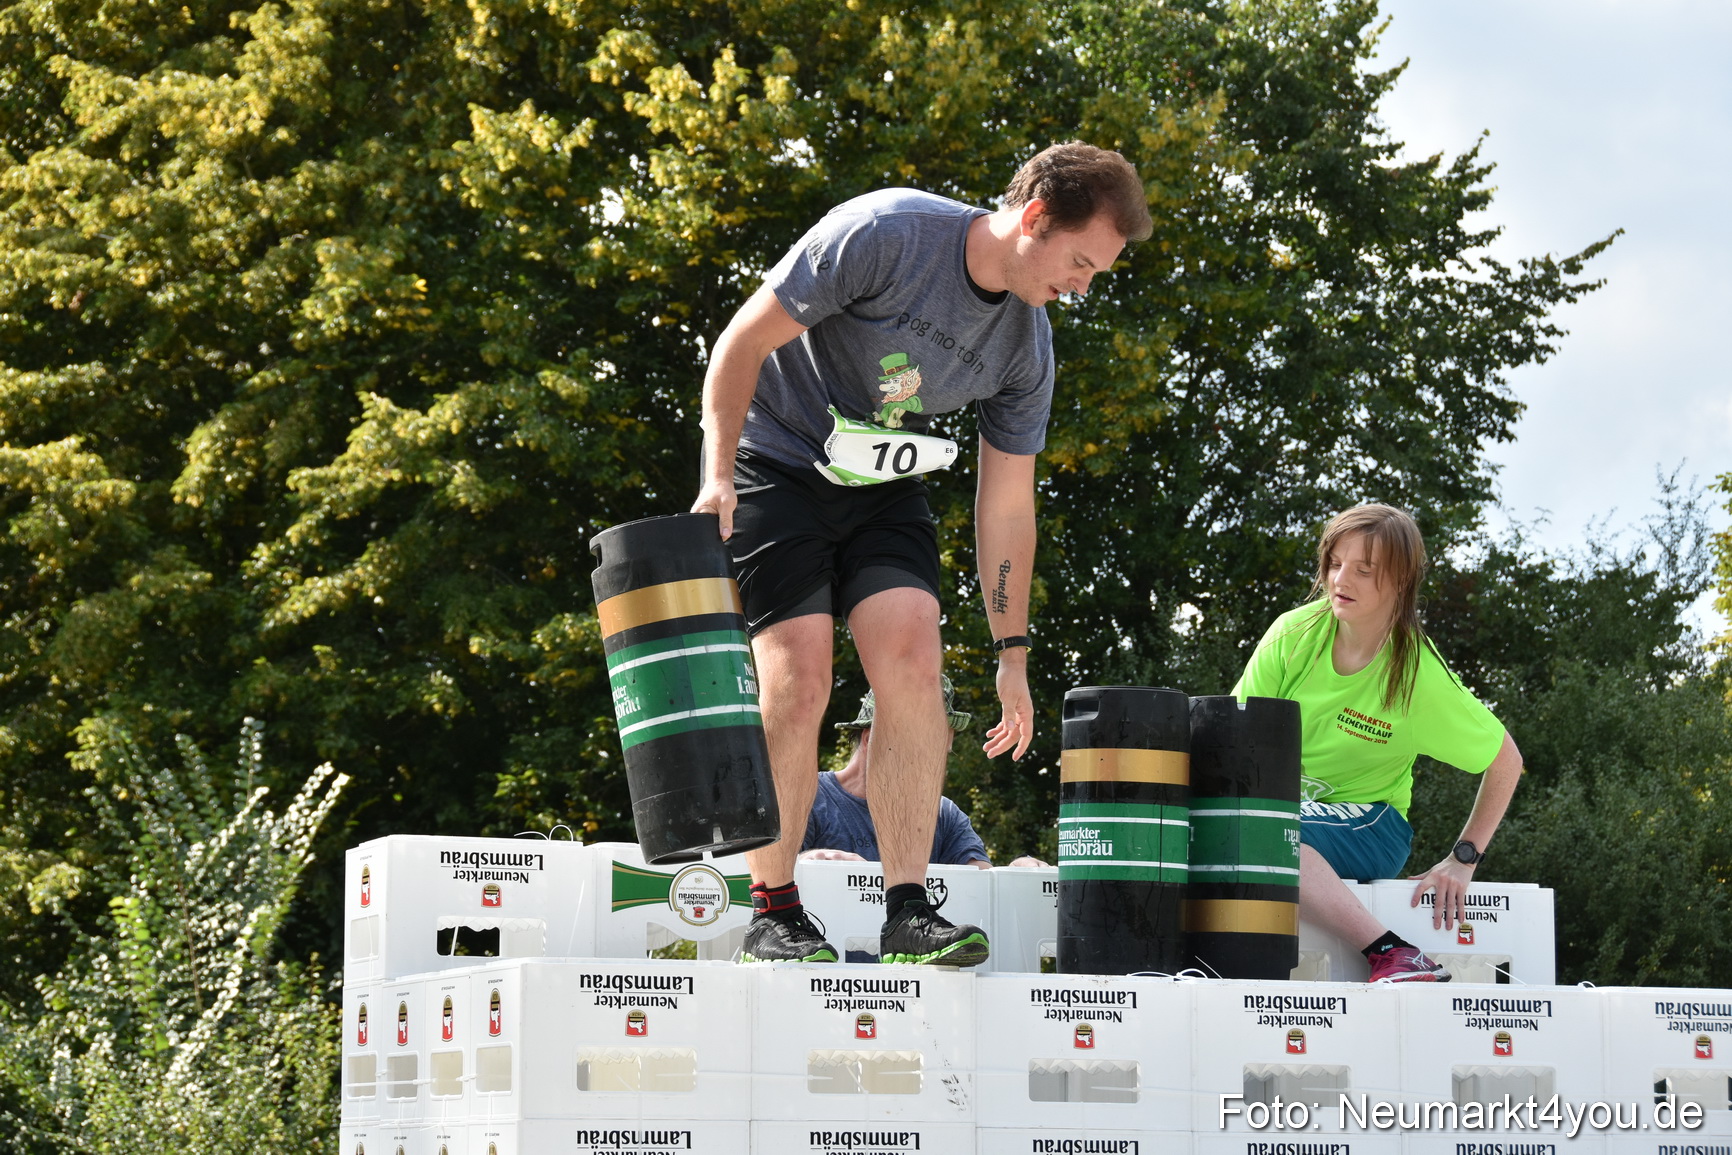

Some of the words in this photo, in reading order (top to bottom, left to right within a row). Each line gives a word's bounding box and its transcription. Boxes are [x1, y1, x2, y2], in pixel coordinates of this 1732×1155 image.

[931, 328, 956, 350] mo
[872, 441, 918, 475] 10
[998, 559, 1011, 614] Benedikt
[1337, 714, 1393, 738] ELEMENTELAUF
[1343, 707, 1392, 730] NEUMARKTER
[1344, 727, 1373, 742] September
[440, 851, 544, 871] Lammsbräu
[453, 870, 529, 883] Neumarkter
[847, 874, 944, 893] Labräu
[678, 893, 720, 901] Lammsbräu
[579, 974, 694, 994] Lammsbräu
[810, 978, 921, 998] Lammsbräu
[594, 994, 678, 1009] Neumarkter
[824, 998, 905, 1013] Neumarkter
[1031, 989, 1137, 1009] Lammsbräu
[1244, 995, 1347, 1015] Lammsbräu
[1452, 998, 1552, 1017] Lammsbräu
[1044, 1008, 1122, 1023] Neumarkter
[1655, 1002, 1732, 1020] mmsbräu
[1257, 1014, 1333, 1028] Neumarkter
[1465, 1016, 1538, 1030] Neumarkter
[576, 1130, 692, 1149] Lammsbräu
[809, 1131, 920, 1151] Lammsbräu
